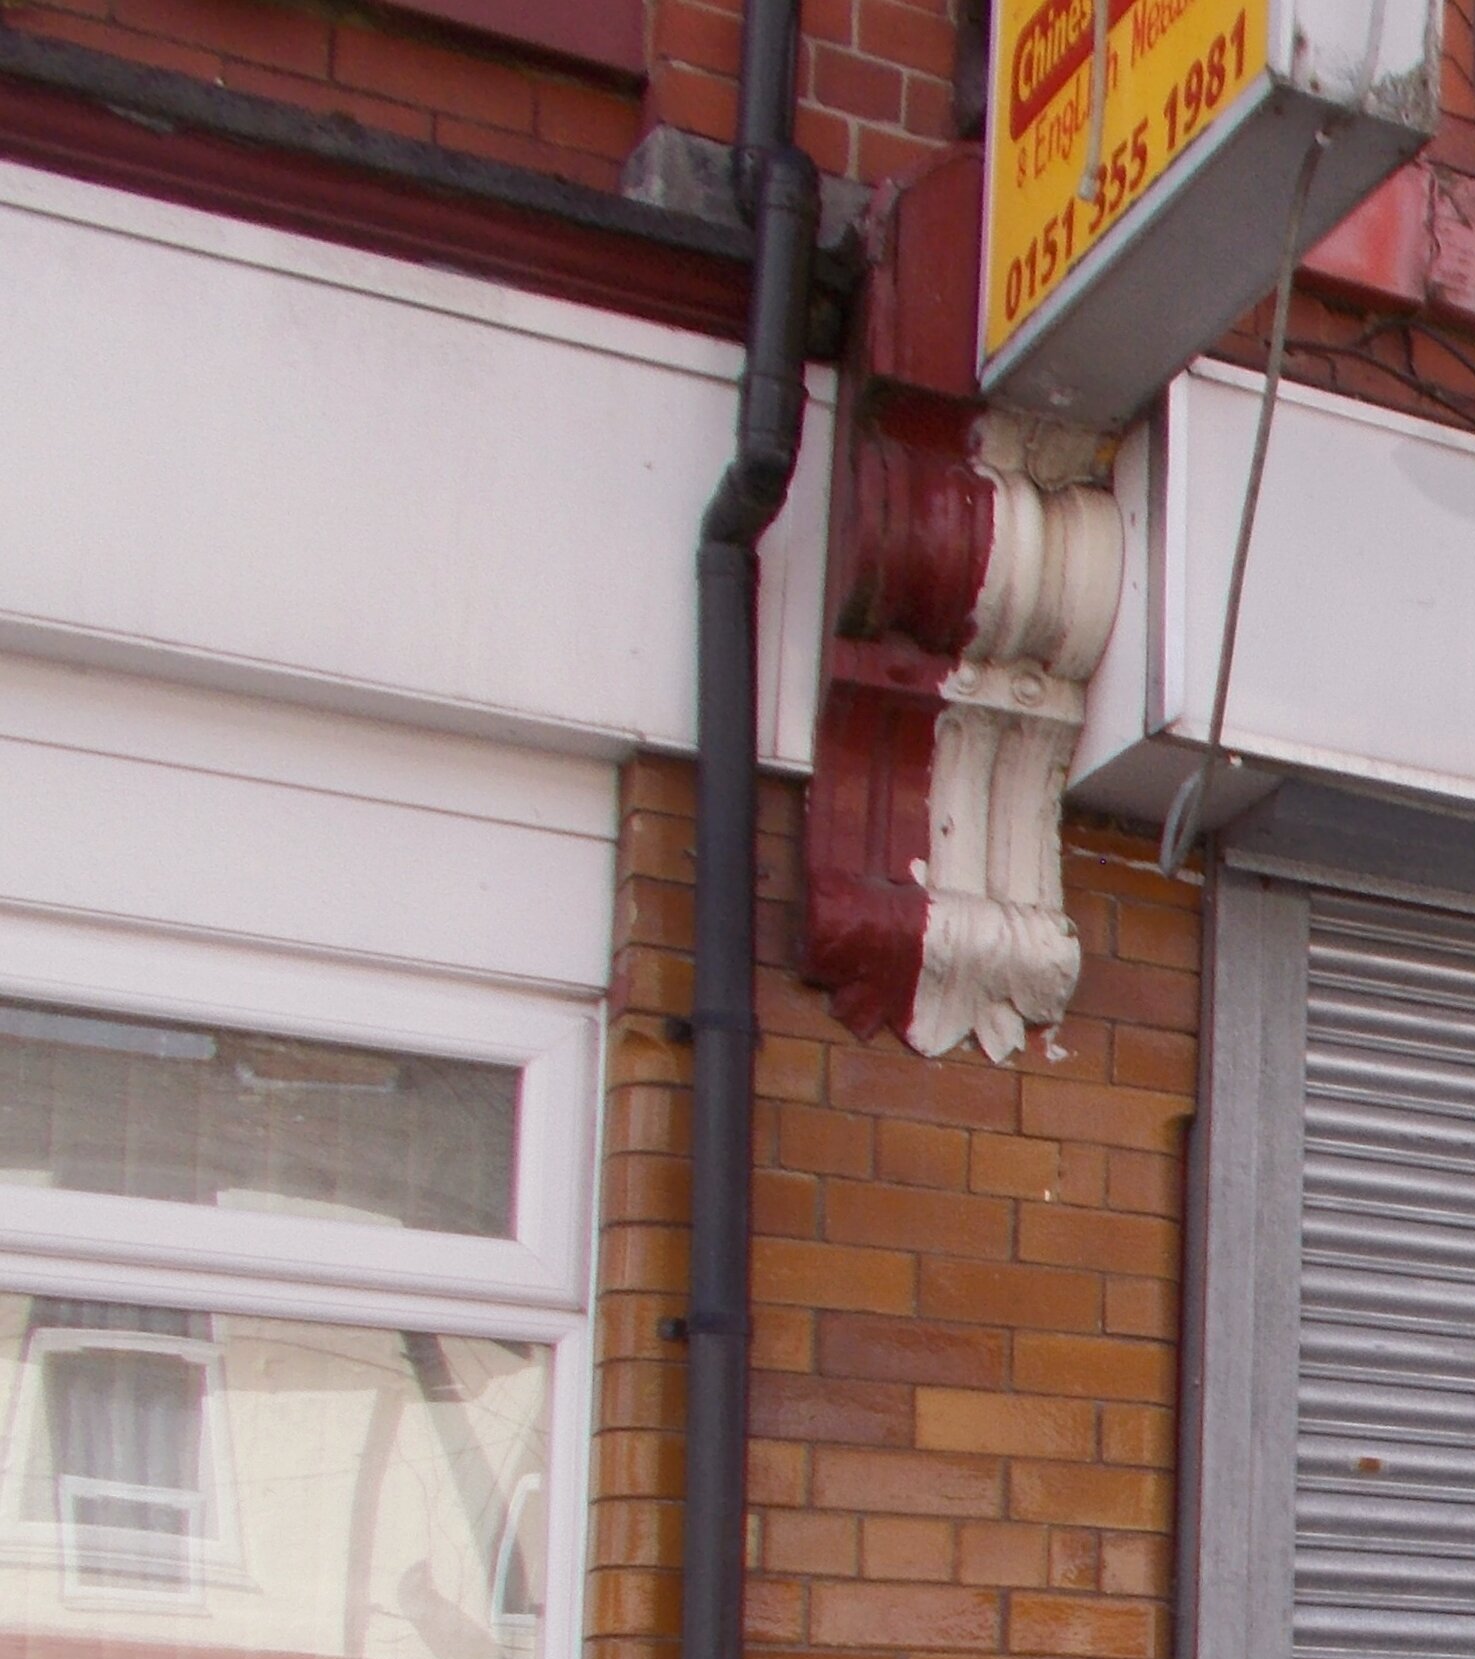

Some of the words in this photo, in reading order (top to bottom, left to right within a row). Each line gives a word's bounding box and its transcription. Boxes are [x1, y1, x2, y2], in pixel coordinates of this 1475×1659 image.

[1005, 198, 1075, 321] 0151
[1089, 117, 1148, 235] 355
[1163, 8, 1246, 153] 1981
